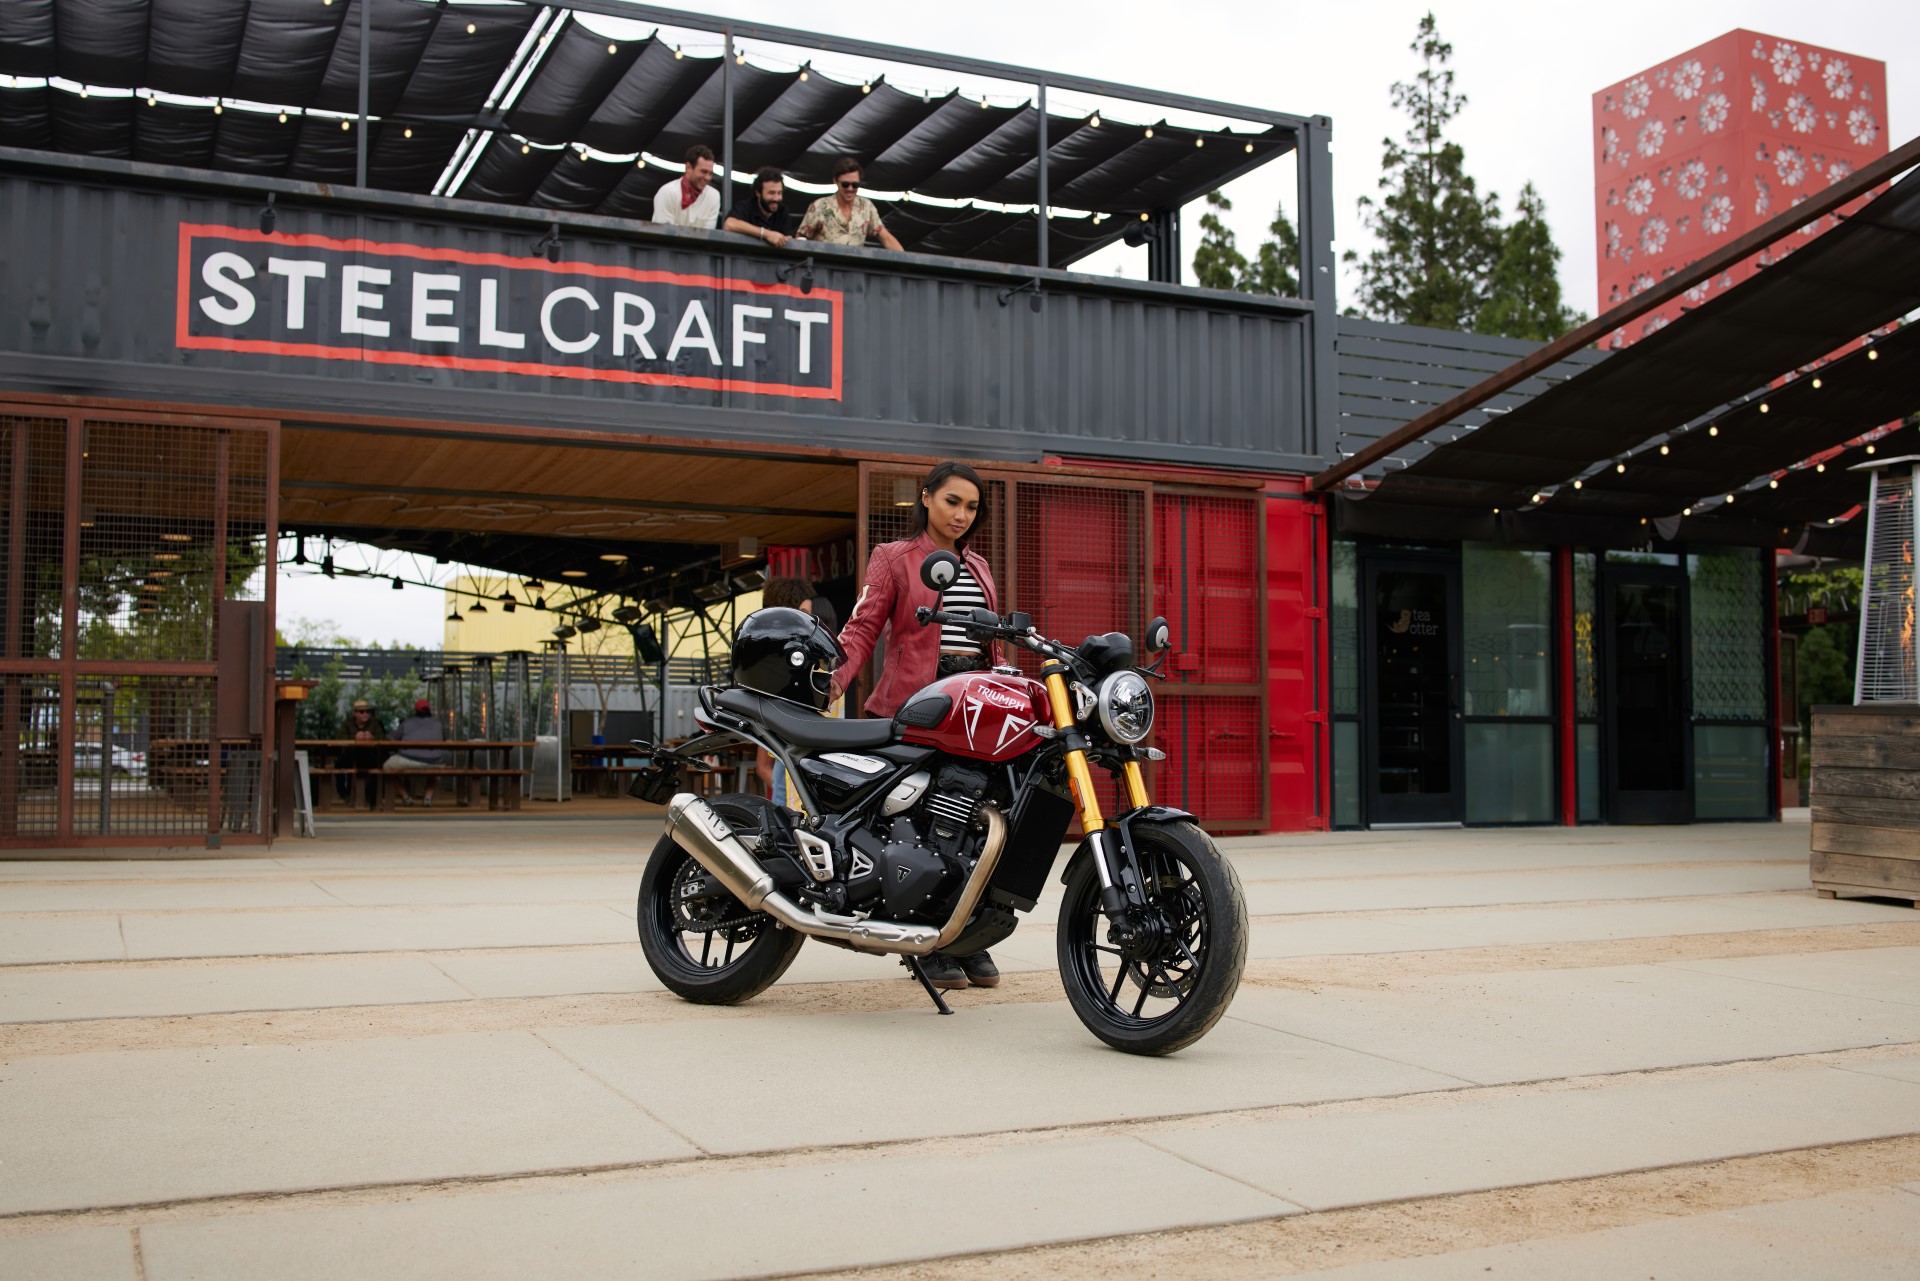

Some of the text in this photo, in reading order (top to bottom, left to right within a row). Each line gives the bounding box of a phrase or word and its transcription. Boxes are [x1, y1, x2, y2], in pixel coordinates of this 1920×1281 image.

[199, 251, 829, 374] STEELCRAFT
[1412, 609, 1431, 621] tea
[1409, 622, 1439, 635] otter
[977, 684, 1026, 712] TRIUMPH
